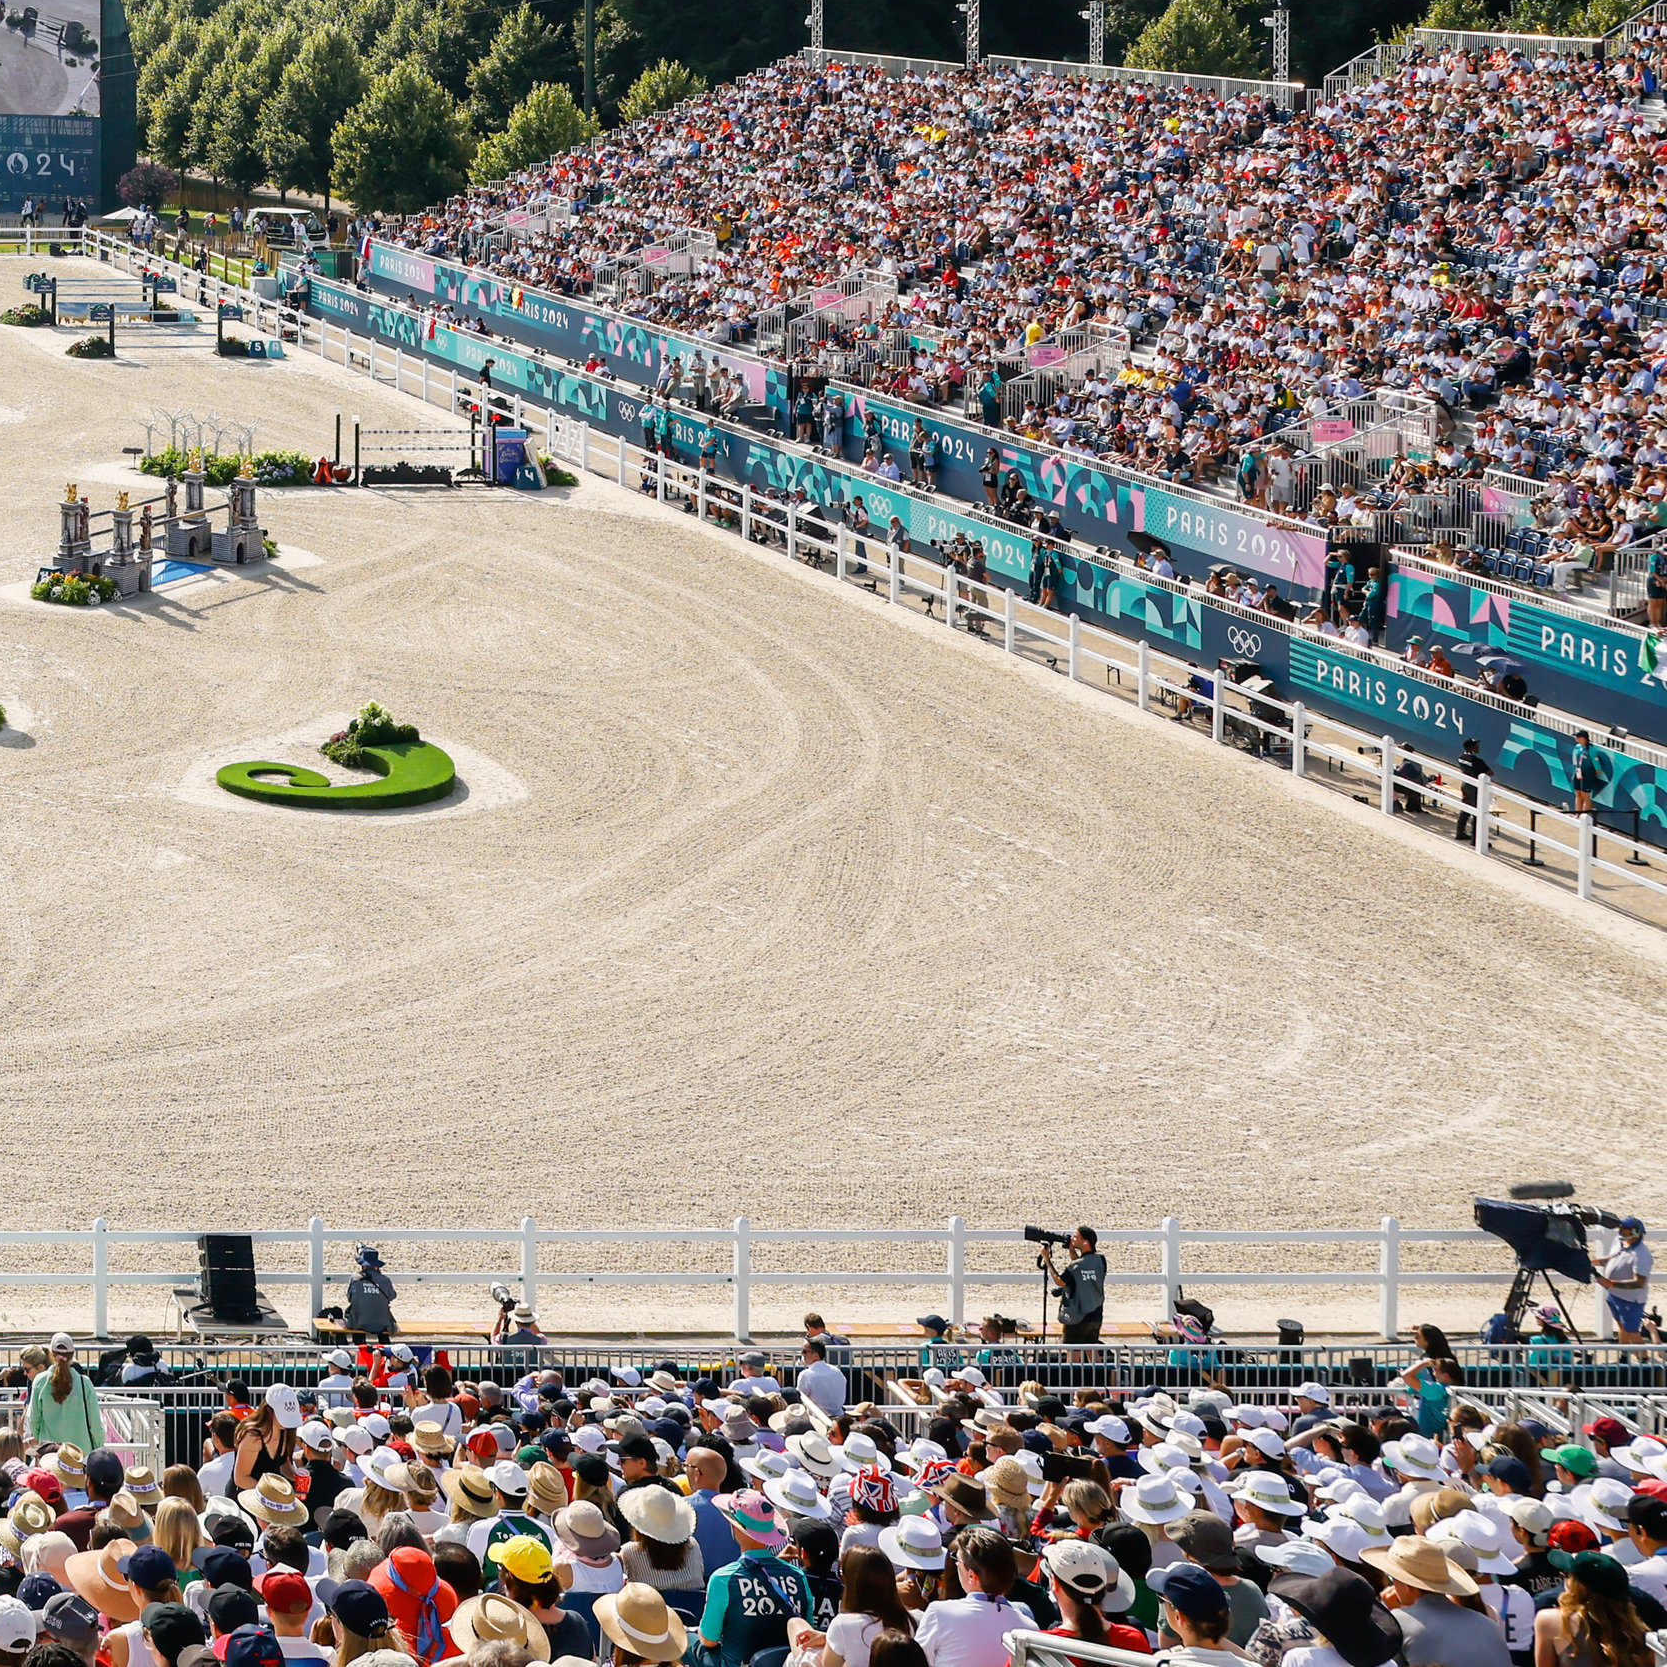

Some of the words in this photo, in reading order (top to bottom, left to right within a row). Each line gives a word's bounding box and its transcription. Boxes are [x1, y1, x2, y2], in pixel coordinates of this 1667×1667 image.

[405, 261, 425, 282] 2024
[340, 296, 359, 317] 2024
[541, 308, 569, 330] 2024
[254, 342, 261, 351] 5
[272, 342, 279, 351] A
[524, 469, 534, 481] 4
[1237, 529, 1296, 568] 2024
[1397, 688, 1463, 735] 2024
